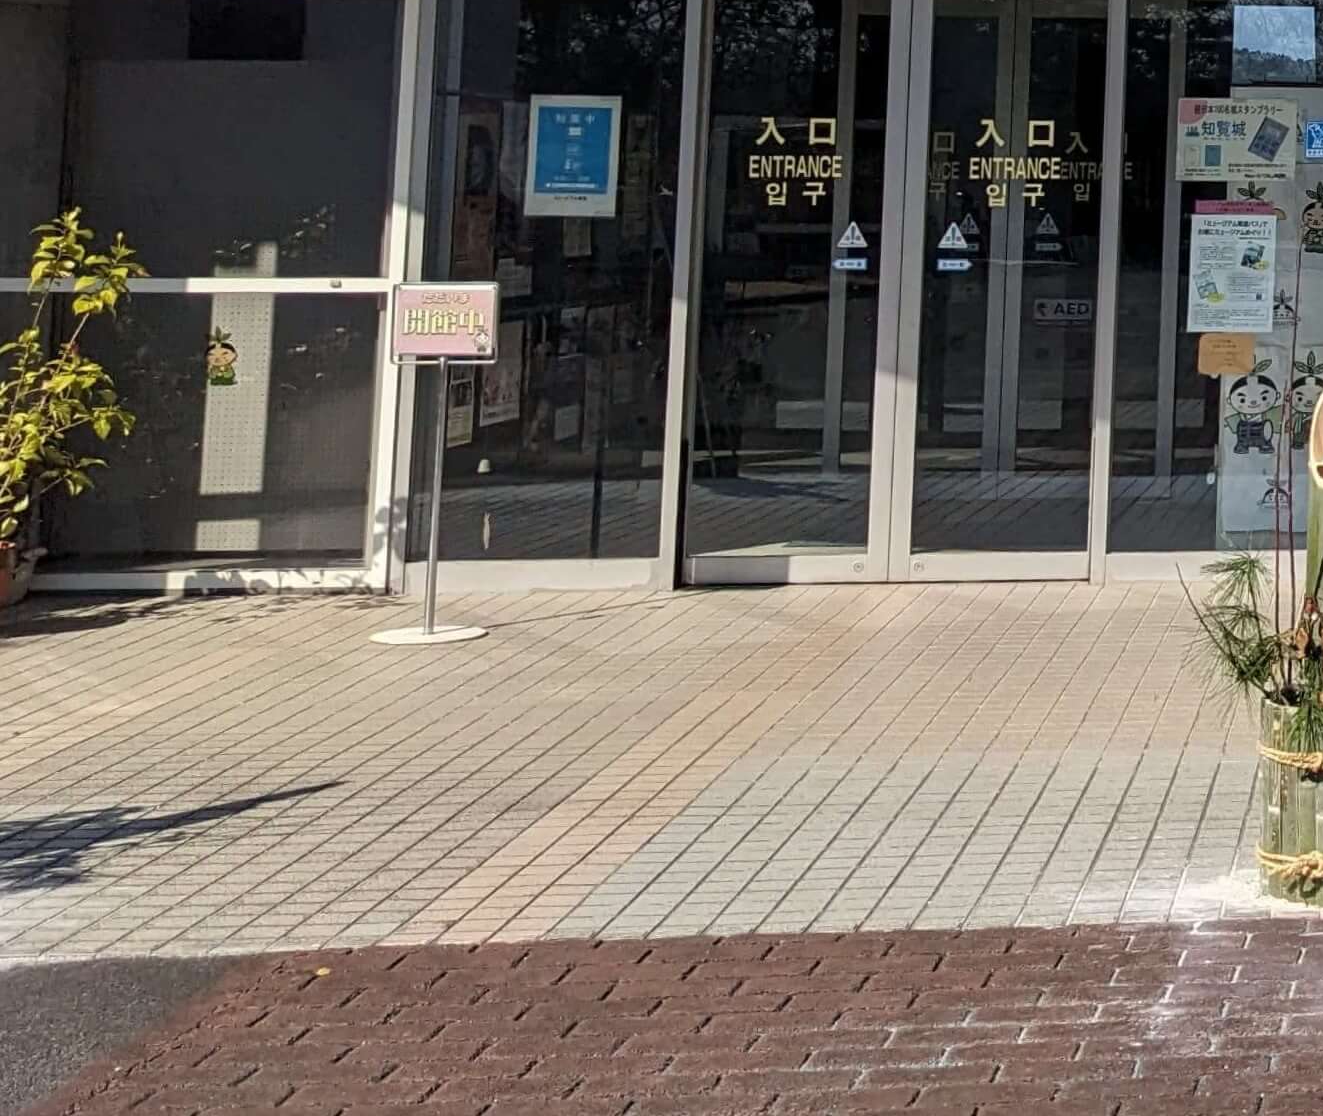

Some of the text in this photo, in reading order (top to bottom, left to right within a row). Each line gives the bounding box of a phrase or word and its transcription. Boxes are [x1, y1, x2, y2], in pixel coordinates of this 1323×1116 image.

[755, 116, 837, 146] 入口
[975, 118, 1056, 147] 入口
[1201, 120, 1247, 137] 知覧城
[748, 155, 843, 179] ENTRANCE
[968, 156, 1062, 181] ENTRANCE
[766, 182, 827, 207] 입구
[985, 183, 1046, 207] 입구
[402, 308, 485, 336] 開館中
[1053, 302, 1091, 317] AED
